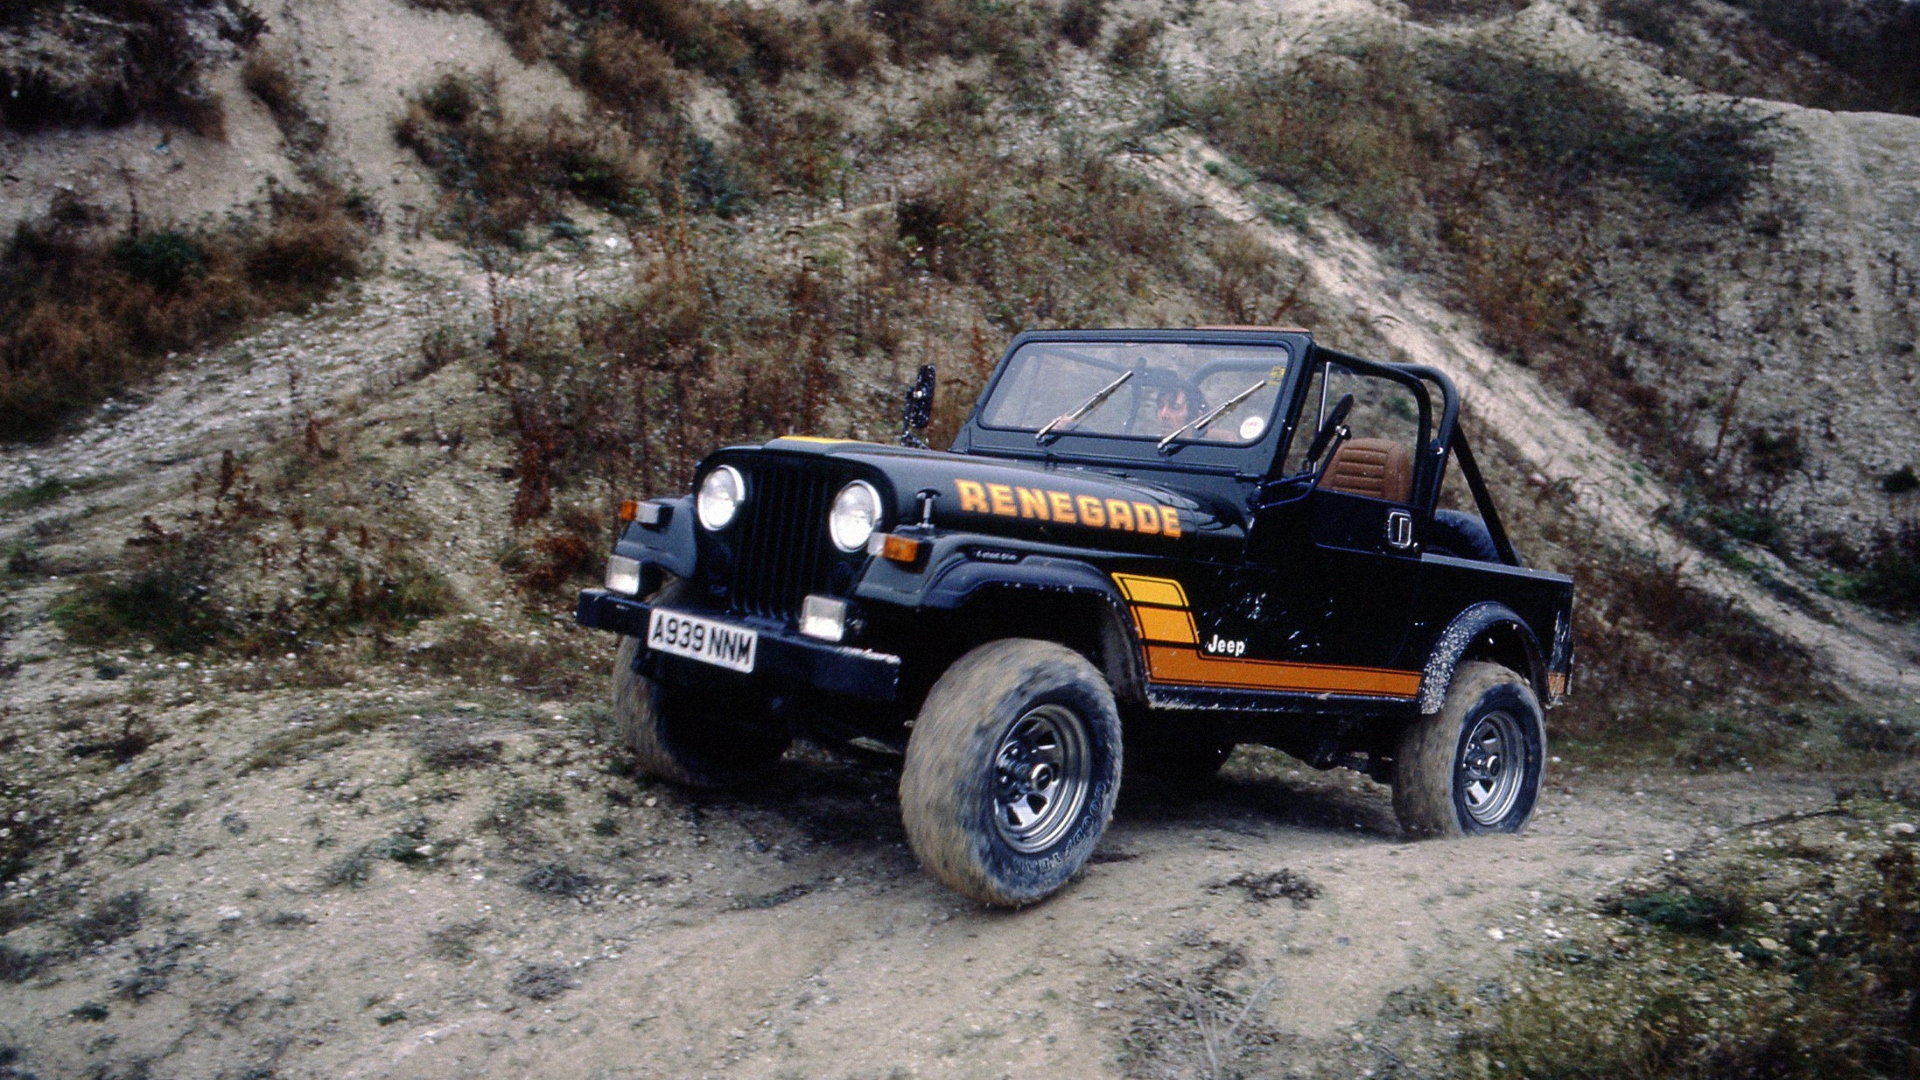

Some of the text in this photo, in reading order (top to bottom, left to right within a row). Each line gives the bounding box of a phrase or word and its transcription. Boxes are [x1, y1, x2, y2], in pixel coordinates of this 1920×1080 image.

[954, 478, 1182, 538] RENEGADE
[653, 613, 753, 666] A939 NNM
[1208, 634, 1246, 657] Jeep
